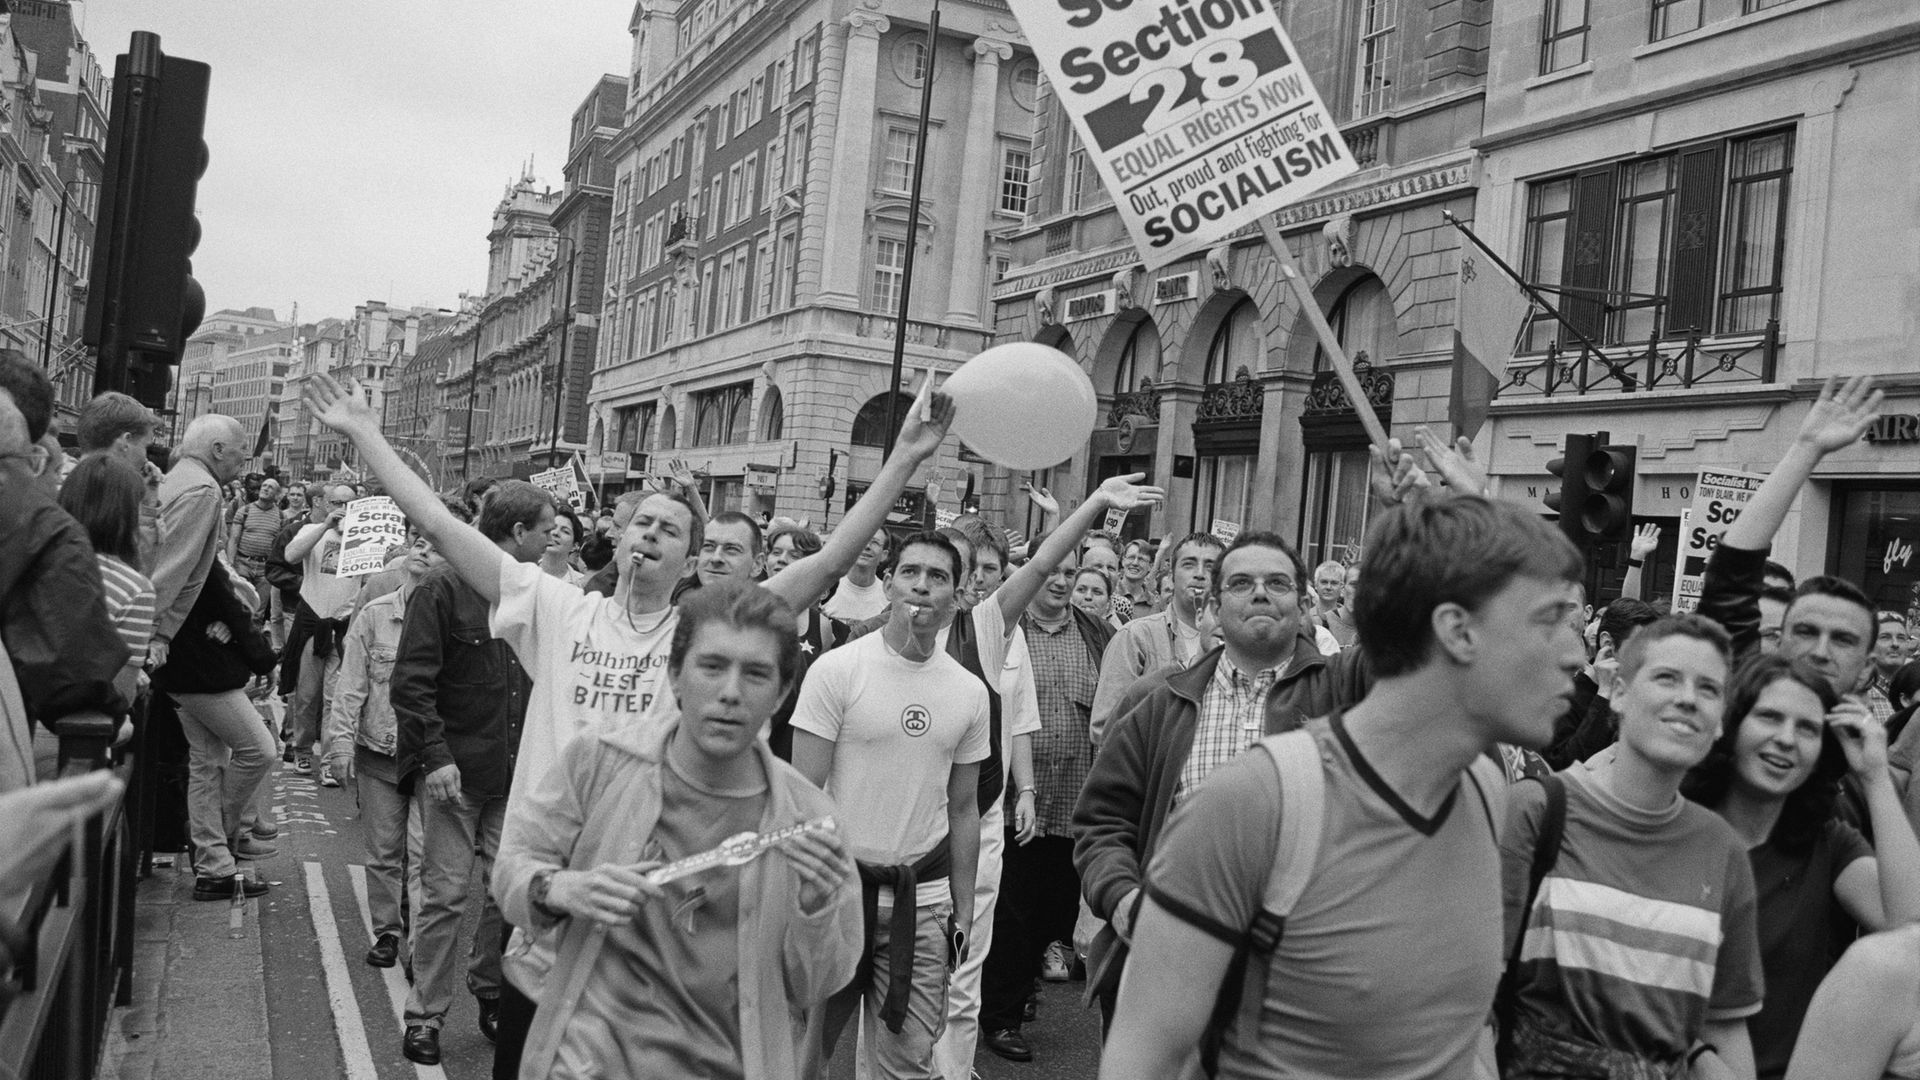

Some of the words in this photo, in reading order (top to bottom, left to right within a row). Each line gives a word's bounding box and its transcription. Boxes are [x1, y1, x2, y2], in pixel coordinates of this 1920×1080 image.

[1110, 133, 1185, 184] EQUAL
[1182, 94, 1259, 148] RIGHTS
[1258, 72, 1305, 111] NOW
[1129, 38, 1258, 136] 28
[1129, 186, 1169, 216] Out,
[1167, 158, 1216, 202] proud
[1217, 142, 1247, 174] and
[1244, 119, 1305, 159] fighting
[1299, 110, 1323, 134] for
[1144, 133, 1341, 248] SOCIALISM
[1703, 472, 1747, 489] Socialist
[1883, 537, 1913, 574] fly
[574, 685, 653, 713] BITTER
